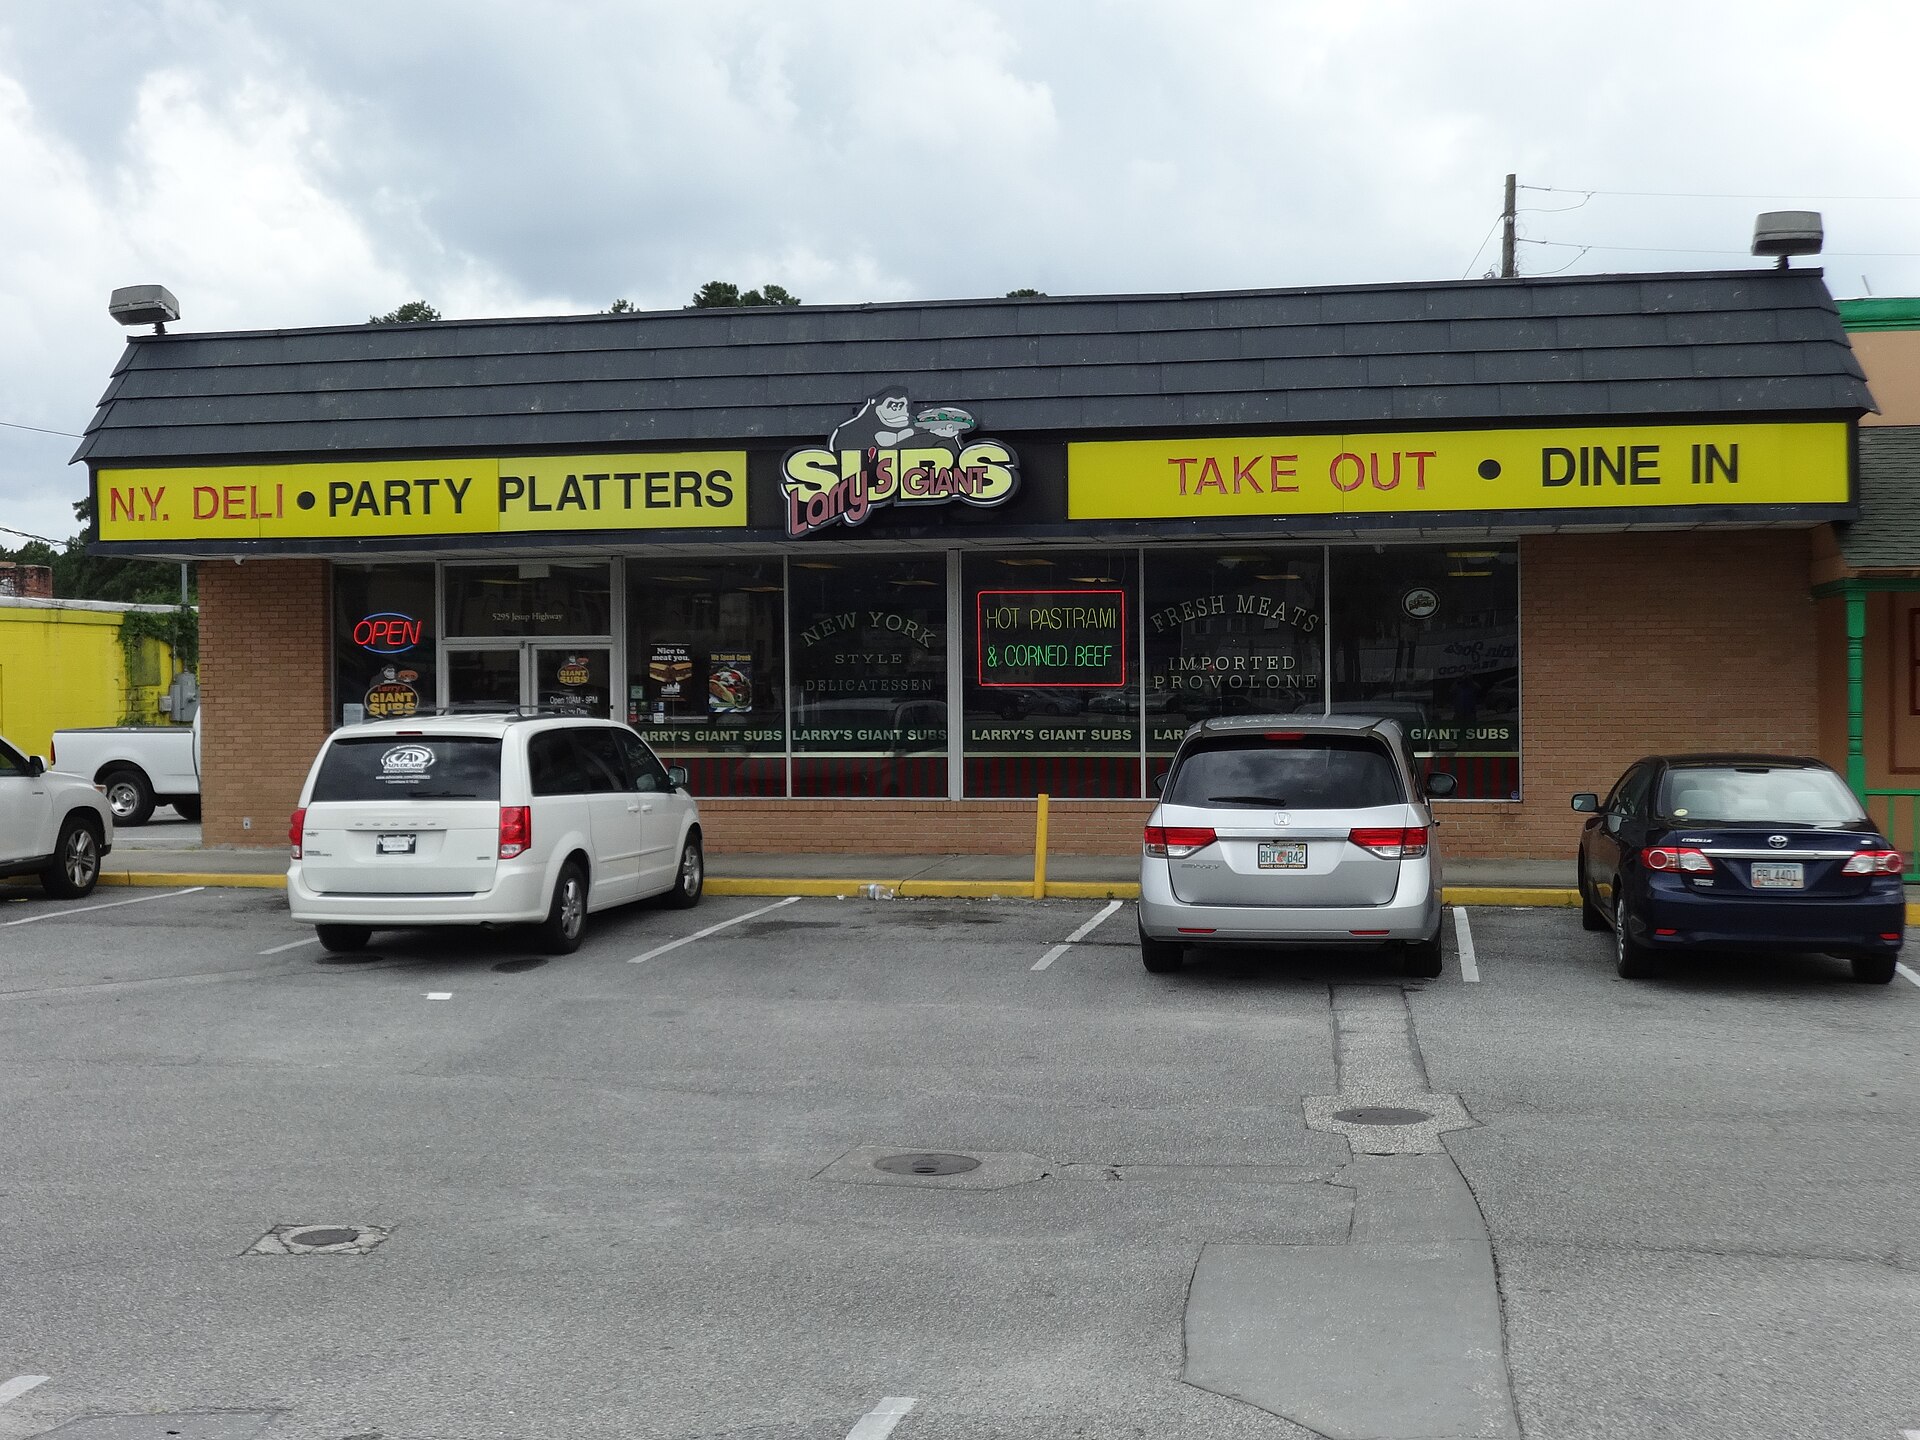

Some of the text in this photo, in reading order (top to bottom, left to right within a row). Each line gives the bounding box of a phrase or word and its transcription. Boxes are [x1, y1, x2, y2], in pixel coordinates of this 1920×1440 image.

[784, 444, 1013, 502] SUBS
[1168, 443, 1739, 495] TAKE OUT DINE IN
[110, 470, 733, 521] N.Y. DELI PARTY PLATTERS
[791, 447, 988, 535] Larry's GIANT
[531, 612, 563, 622] Highway
[986, 607, 1116, 630] HOT PASTRAMI
[1151, 594, 1320, 633] FRESH MEATS
[353, 620, 422, 645] OPEN
[800, 611, 936, 648] NEW YORK
[835, 654, 902, 664] STYLE
[987, 644, 1113, 667] & CORNED BEEF
[1168, 656, 1296, 671] IMPORTED
[806, 679, 932, 691] DELICATESSEN
[1153, 674, 1317, 689] PROVOLONE
[369, 692, 414, 703] GIANT
[550, 696, 565, 704] Open
[368, 702, 416, 715] SUBS
[639, 730, 782, 742] ARRY'S GIANT SUBS
[792, 730, 947, 741] LARRY'S GIANT SUBS
[971, 729, 1132, 741] LARRY'S GIANT SUBS
[1153, 729, 1188, 740] LAR
[1410, 728, 1509, 740] GIANT SUBS
